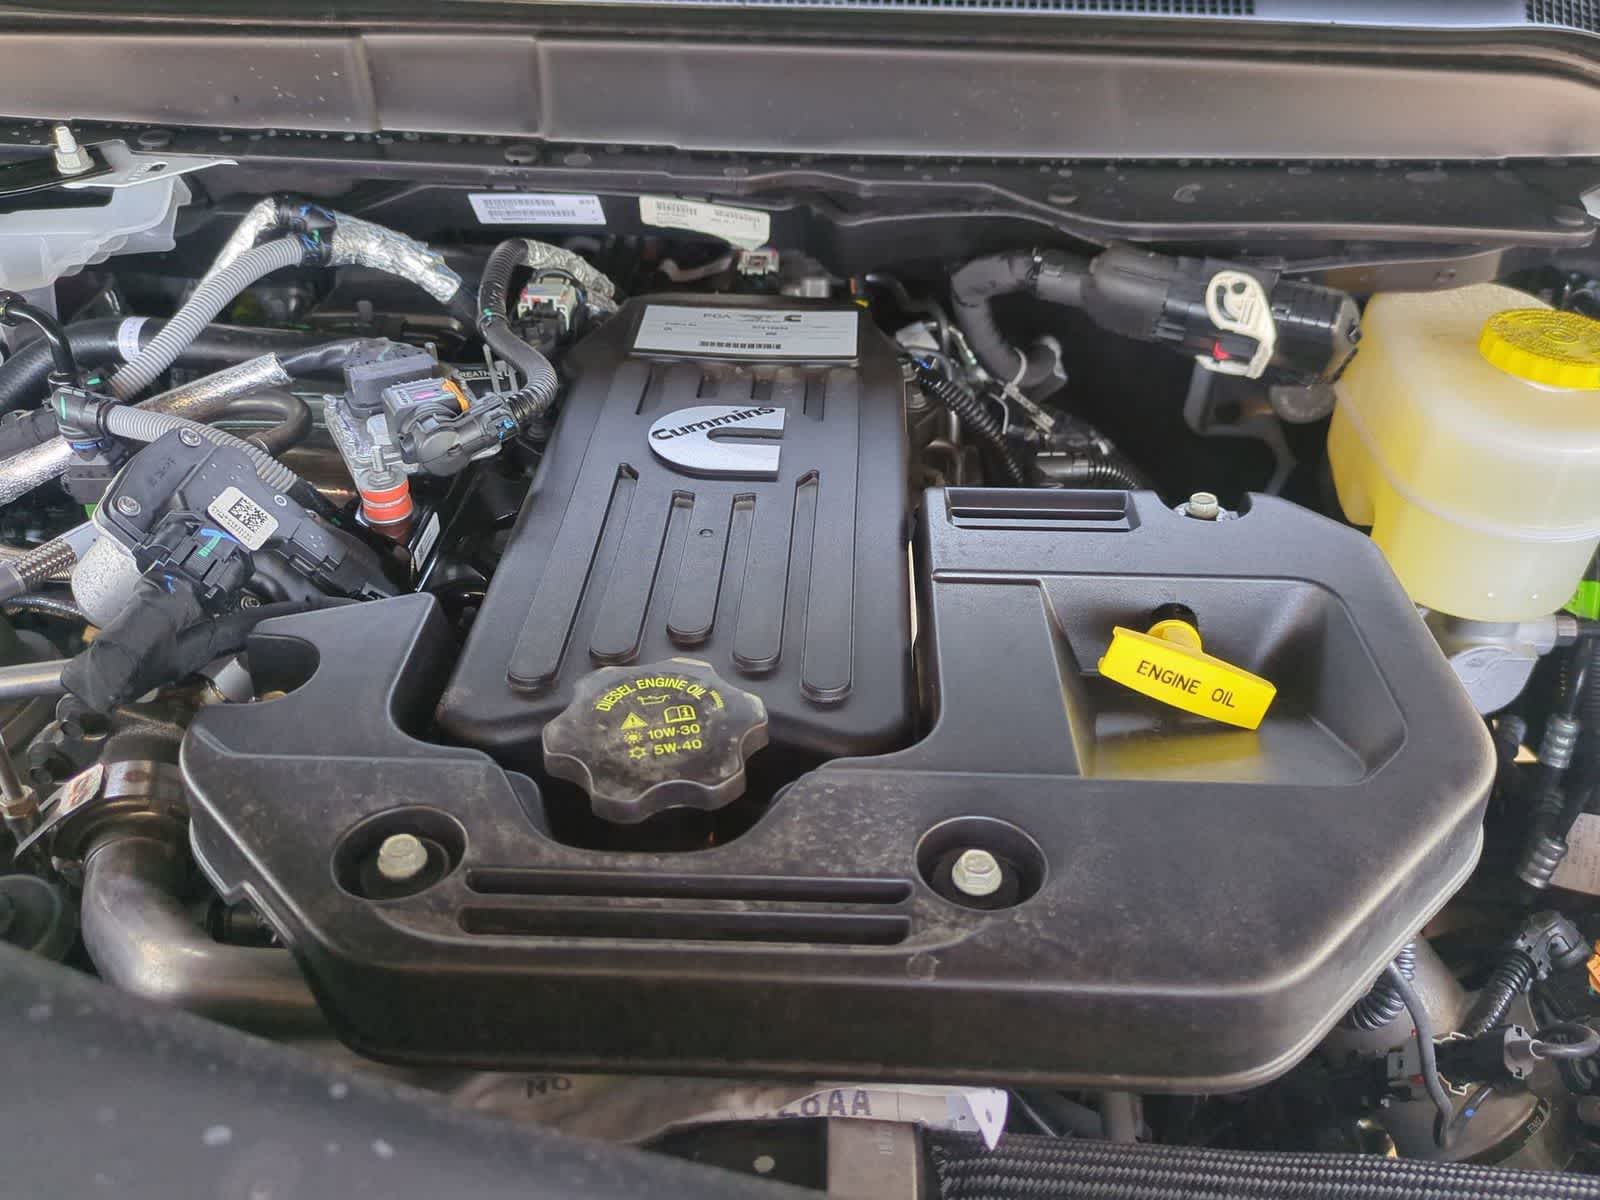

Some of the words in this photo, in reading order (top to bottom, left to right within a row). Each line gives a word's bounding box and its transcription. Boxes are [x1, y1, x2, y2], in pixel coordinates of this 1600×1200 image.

[651, 406, 777, 440] Cummins
[596, 684, 637, 712] DIESEL
[636, 677, 688, 690] ENGINE
[686, 683, 706, 700] OIL
[1136, 659, 1202, 695] ENGINE
[1211, 687, 1237, 709] OIL
[648, 723, 701, 740] 10W-30
[654, 739, 703, 756] 5W-40
